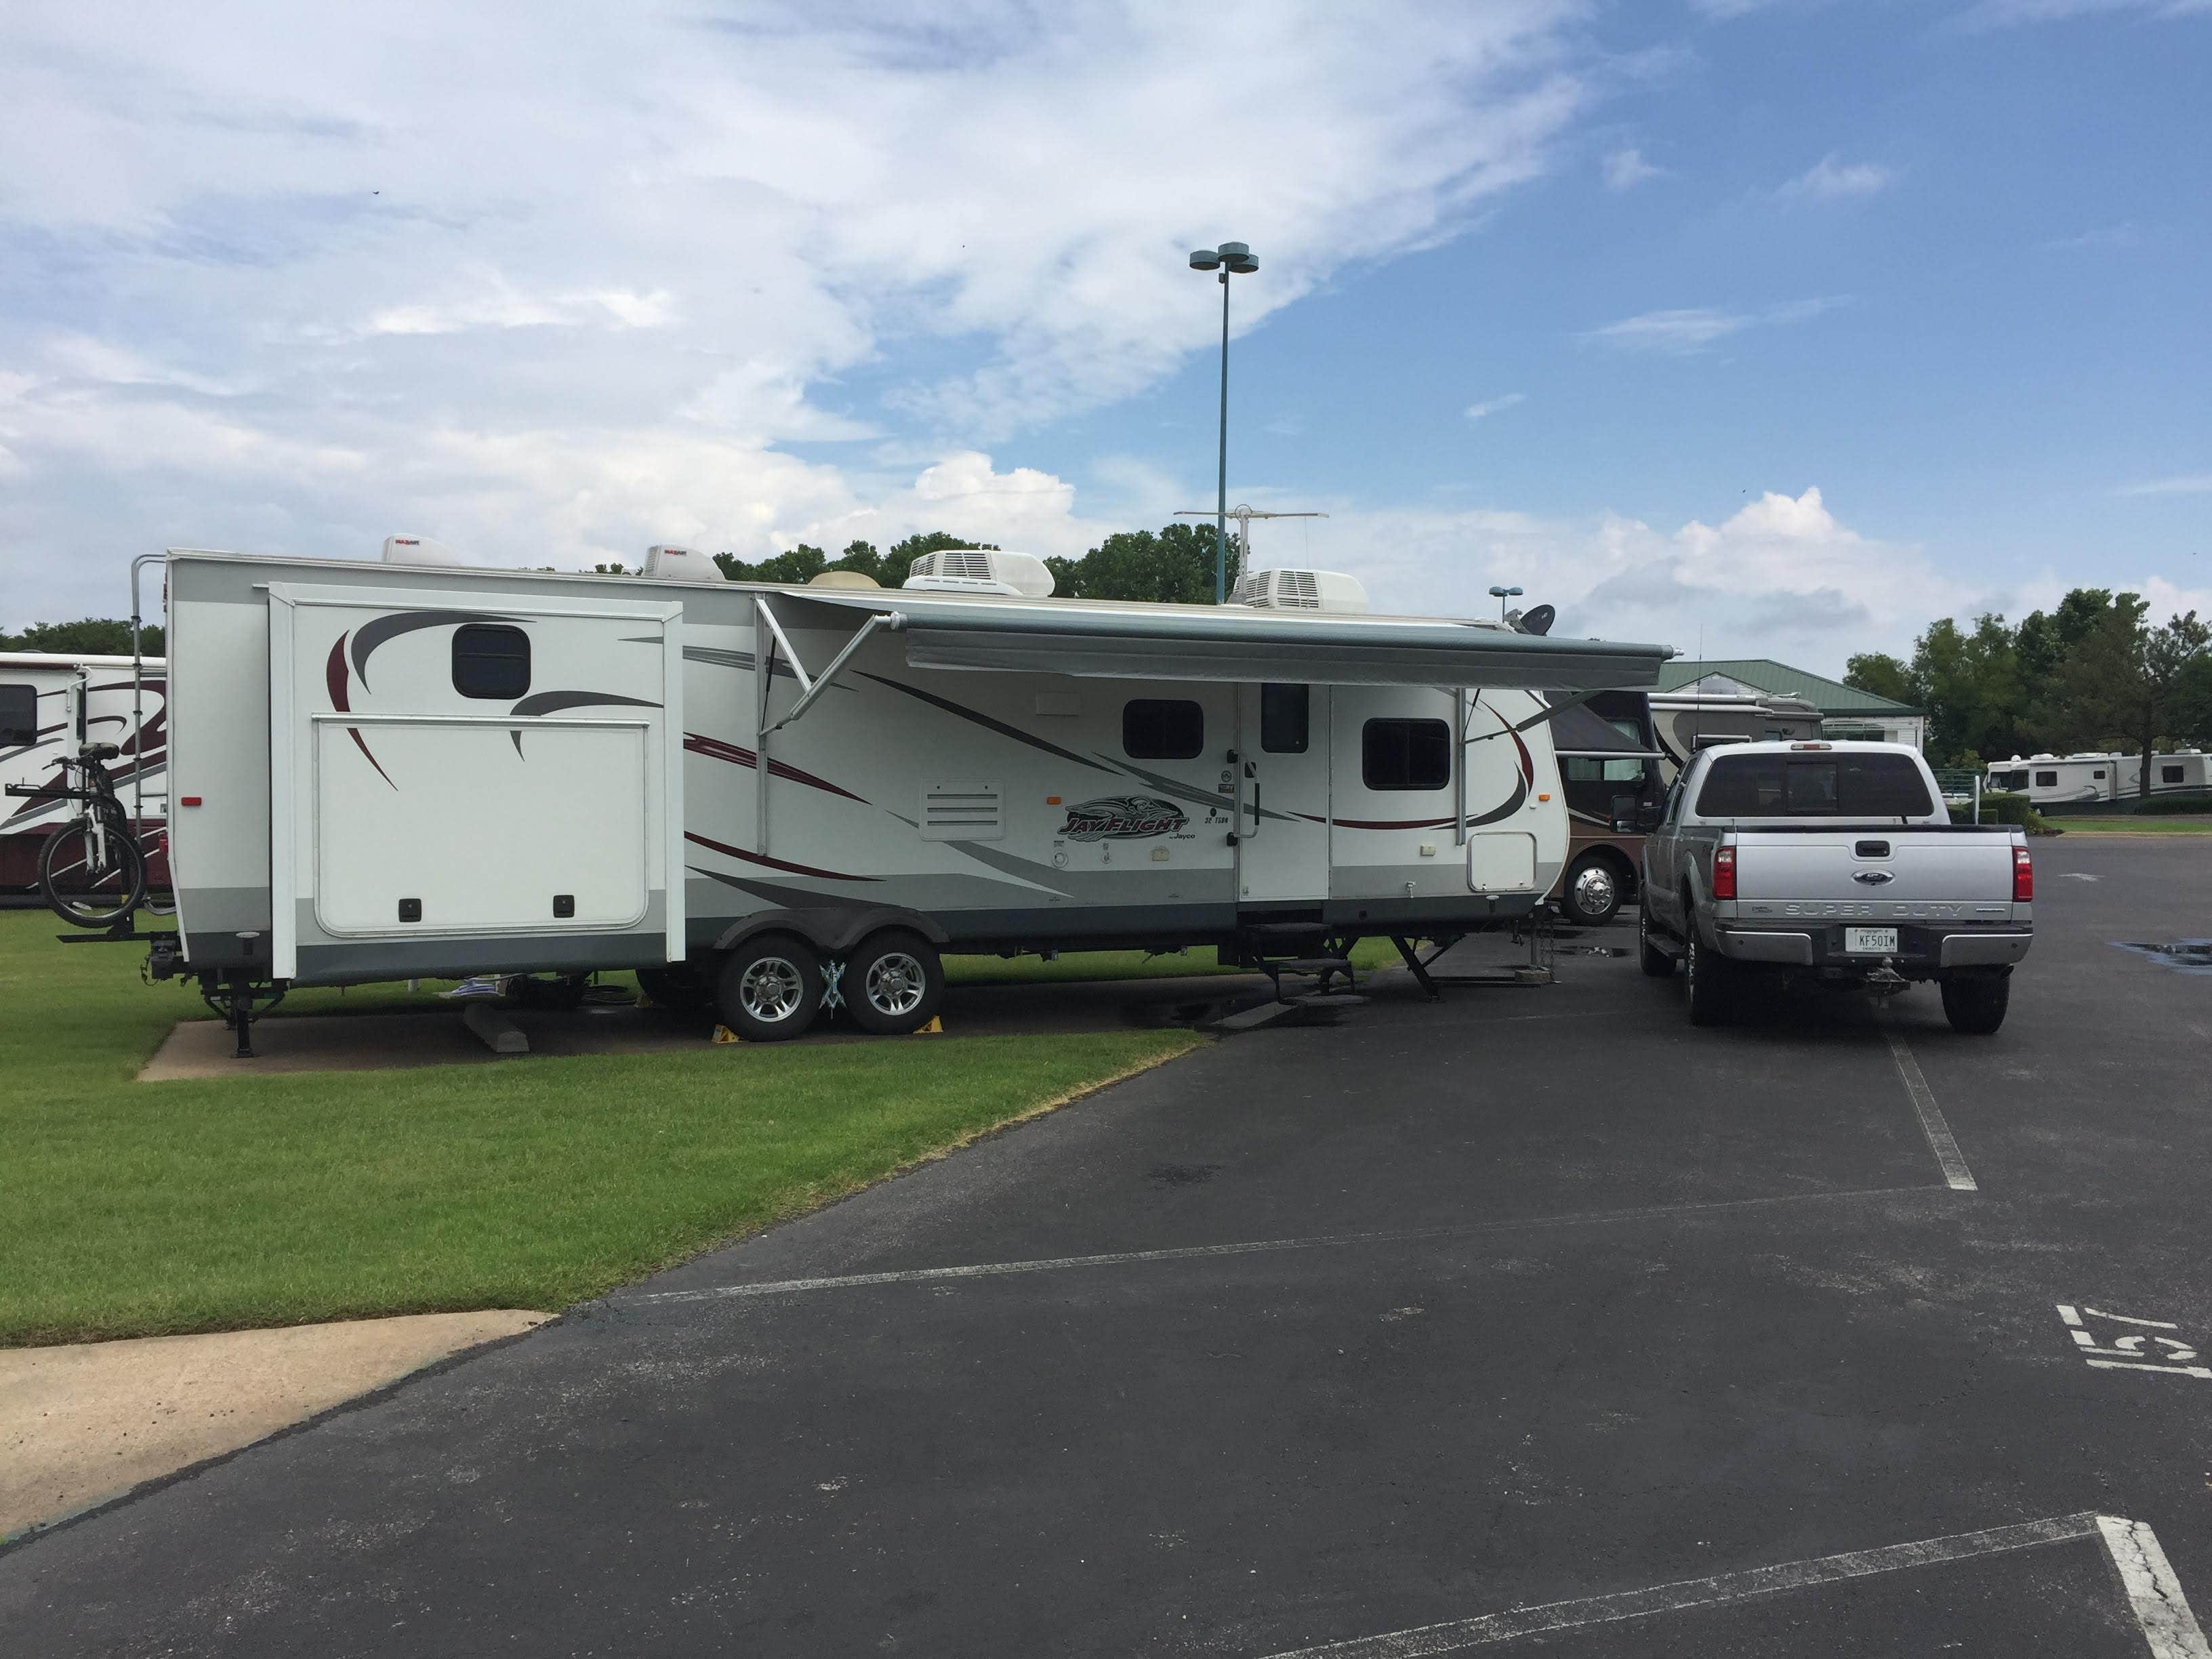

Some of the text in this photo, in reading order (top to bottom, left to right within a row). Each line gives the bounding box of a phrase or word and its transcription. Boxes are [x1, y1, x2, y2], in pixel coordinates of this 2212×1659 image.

[1103, 817, 1189, 833] FLIGHT
[1785, 903, 1874, 916] SUPER
[1892, 904, 1963, 916] DUTY
